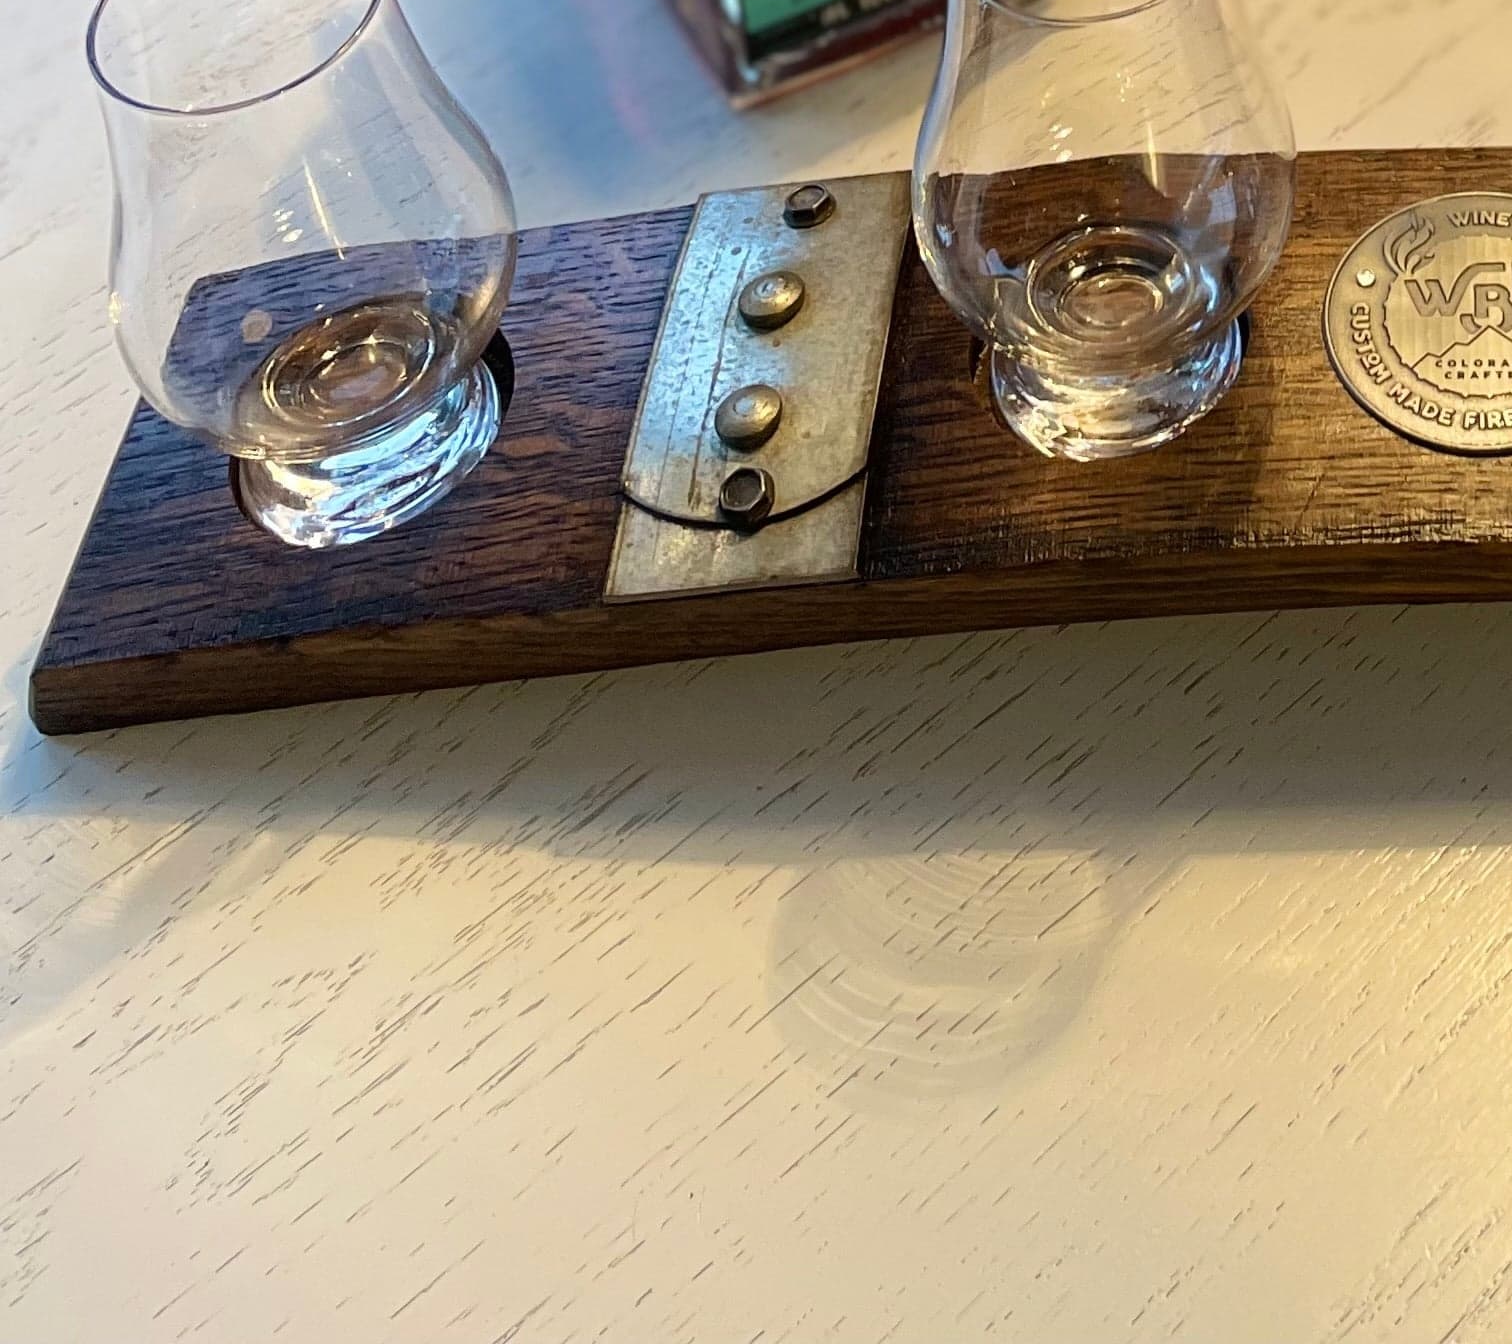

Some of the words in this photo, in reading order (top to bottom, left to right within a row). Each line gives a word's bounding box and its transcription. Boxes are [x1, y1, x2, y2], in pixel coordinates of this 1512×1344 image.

[1447, 210, 1512, 228] WINE
[1350, 301, 1393, 385] CUSTOM
[1389, 382, 1456, 427] MADE
